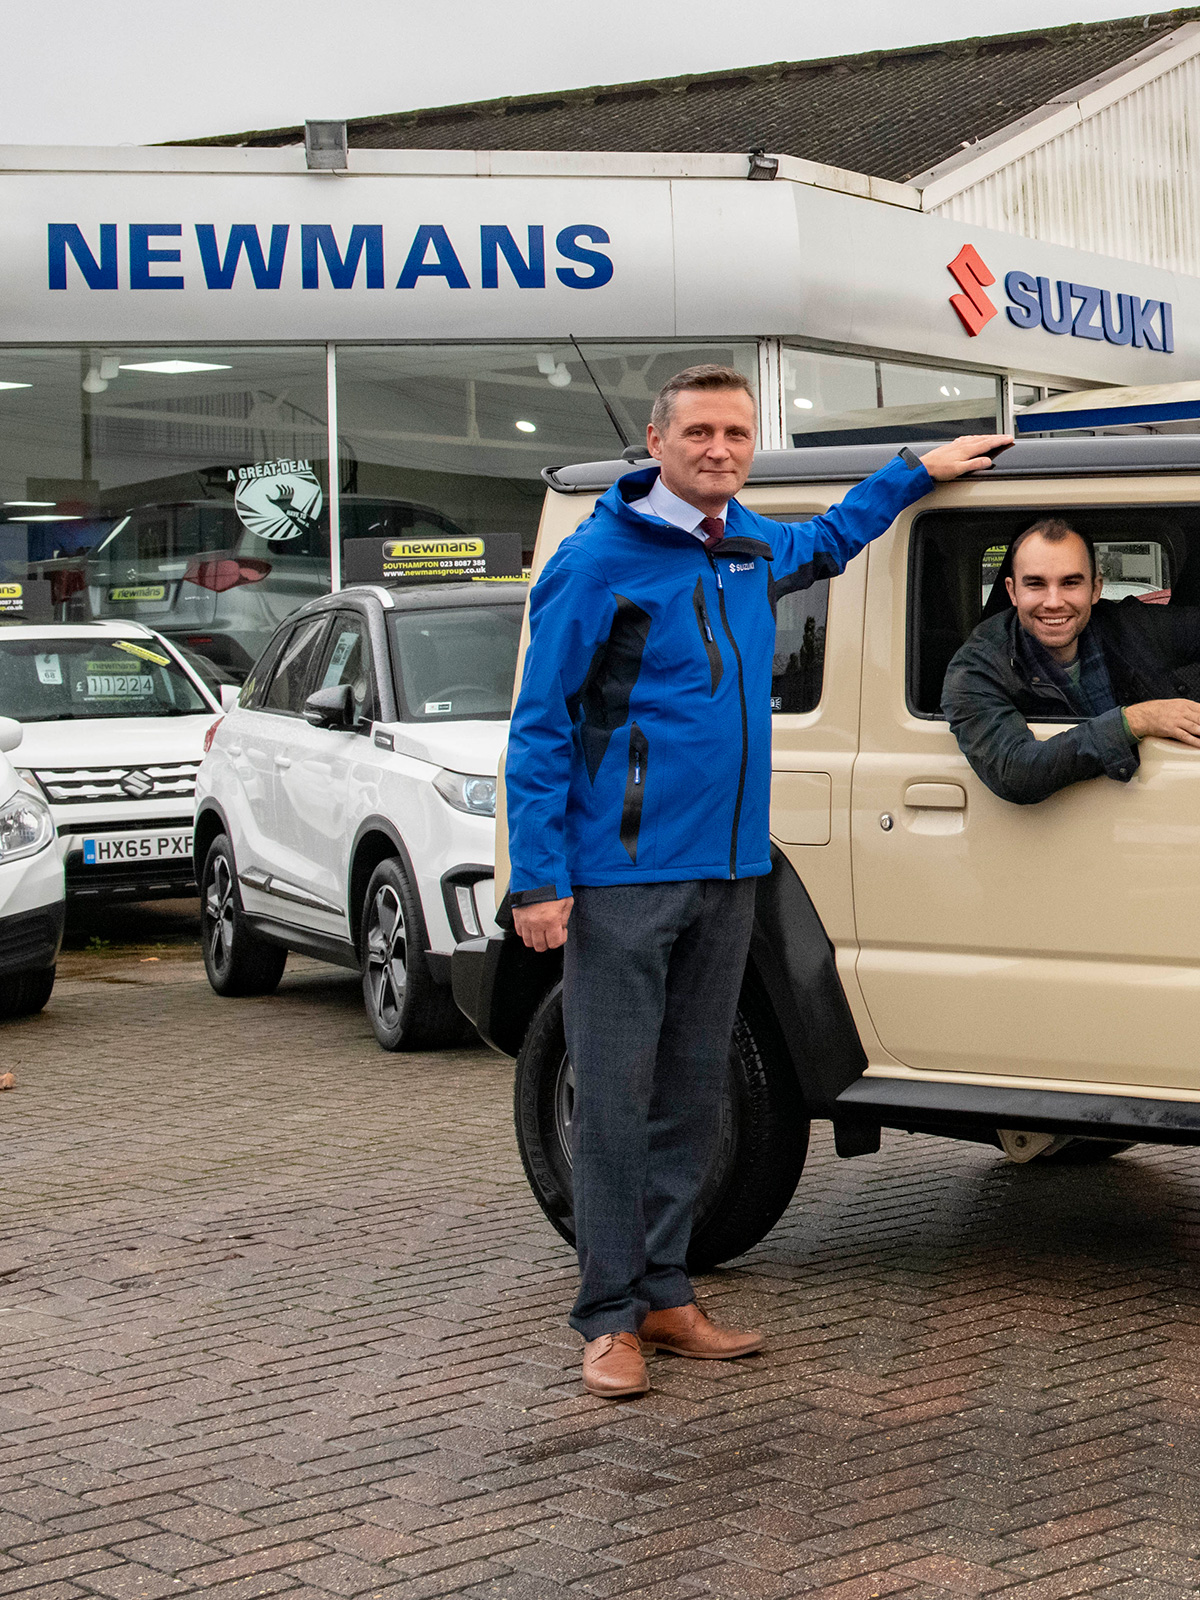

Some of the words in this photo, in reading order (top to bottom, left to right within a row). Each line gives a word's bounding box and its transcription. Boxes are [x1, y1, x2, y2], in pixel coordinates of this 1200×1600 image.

[48, 223, 613, 290] NEWMANS
[1004, 270, 1174, 354] SUZUKI
[227, 469, 237, 482] A
[238, 463, 279, 480] GREAT
[280, 459, 313, 475] DEAL
[401, 541, 477, 554] newmans
[383, 561, 439, 570] SOUTHAMPTON
[454, 559, 471, 567] 8087
[473, 559, 486, 567] 388
[383, 567, 487, 577] www.newmansgroup.co.uk
[118, 587, 161, 599] newmans
[98, 839, 152, 860] HX65
